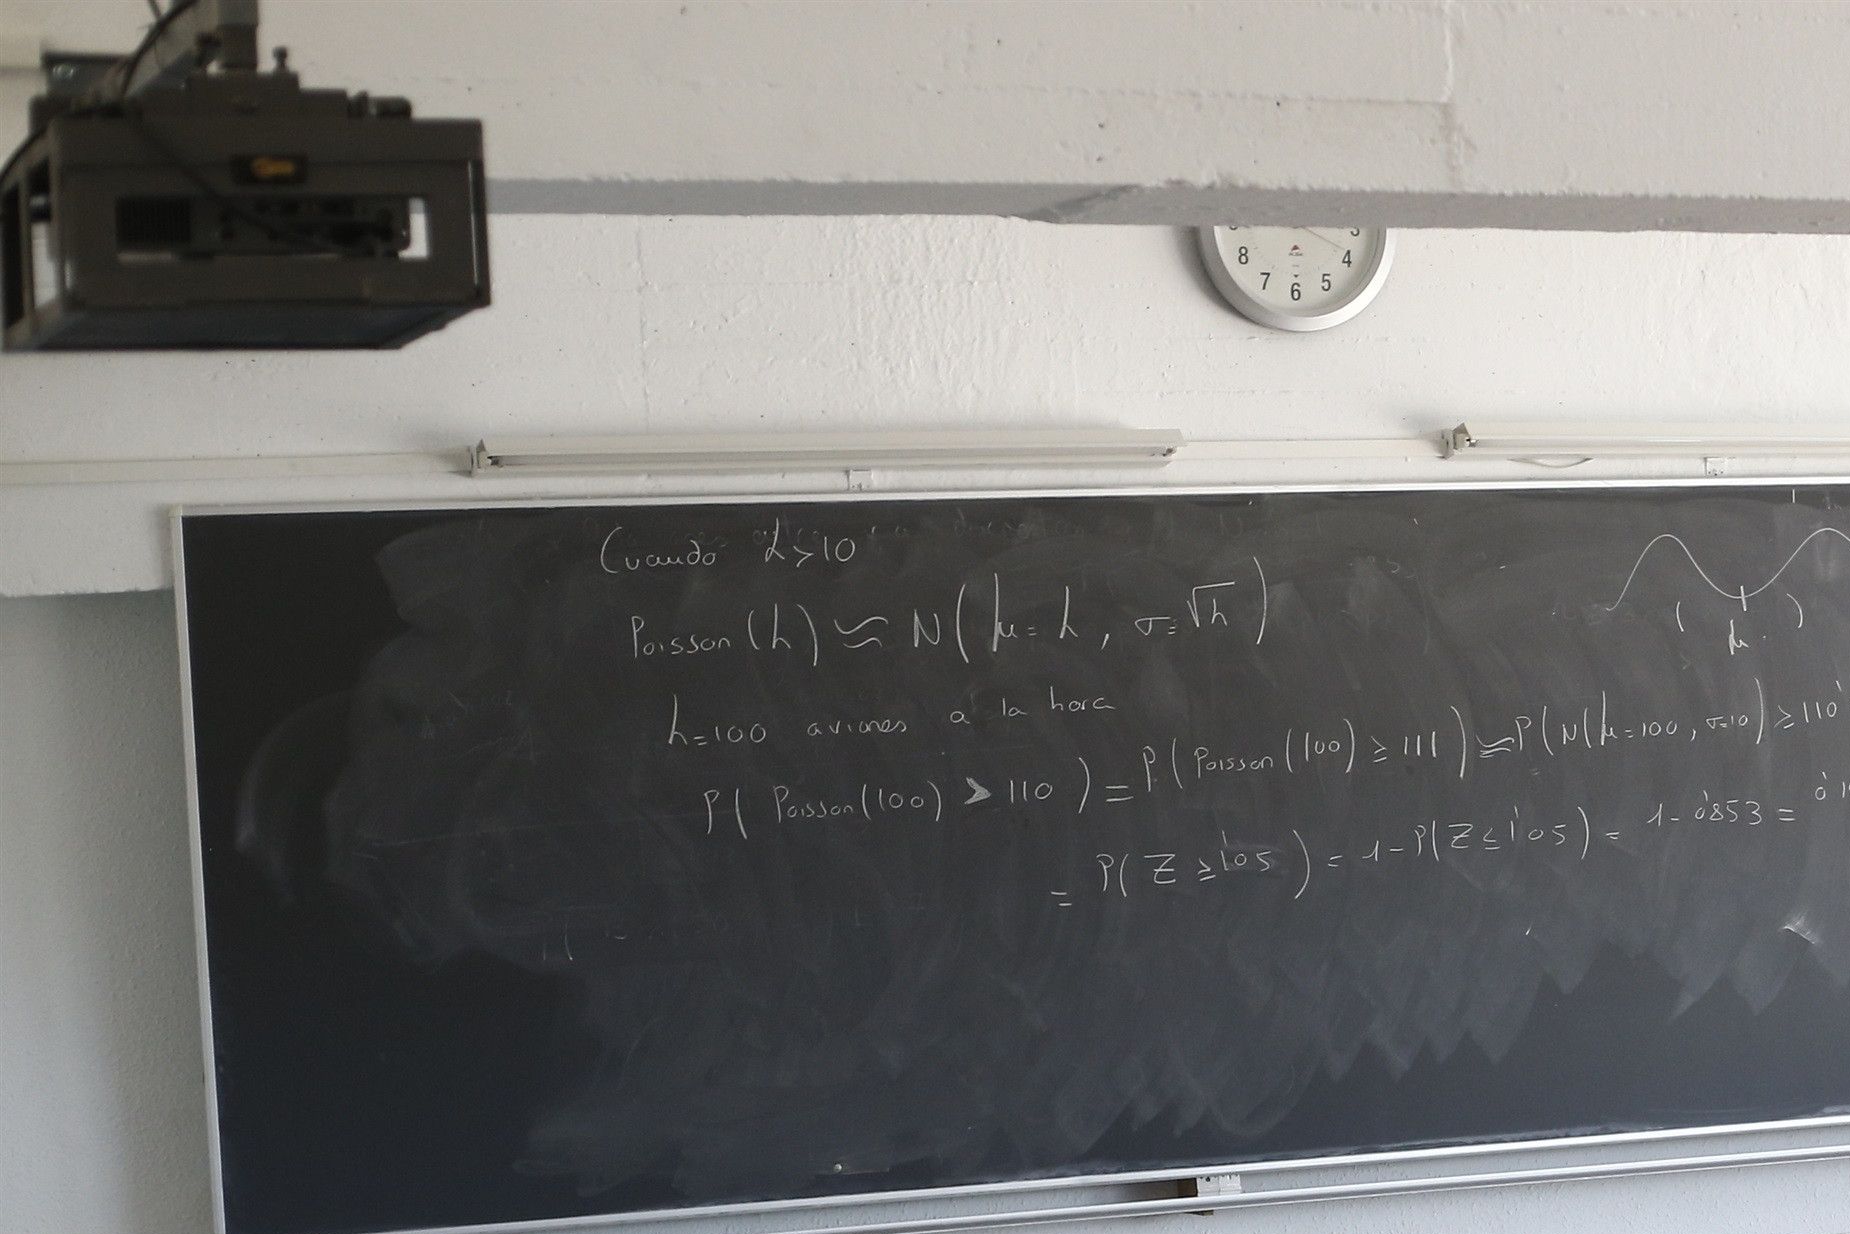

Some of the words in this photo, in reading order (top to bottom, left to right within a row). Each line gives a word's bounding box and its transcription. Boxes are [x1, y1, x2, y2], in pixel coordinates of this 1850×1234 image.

[1238, 246, 1249, 265] 8
[1341, 249, 1352, 268] 4
[1259, 272, 1271, 291] 7
[1321, 273, 1332, 292] 5
[1290, 282, 1301, 301] 6
[600, 526, 718, 574] Cuando
[949, 710, 970, 724] a
[1002, 698, 1027, 716] la
[1050, 686, 1116, 711] hora
